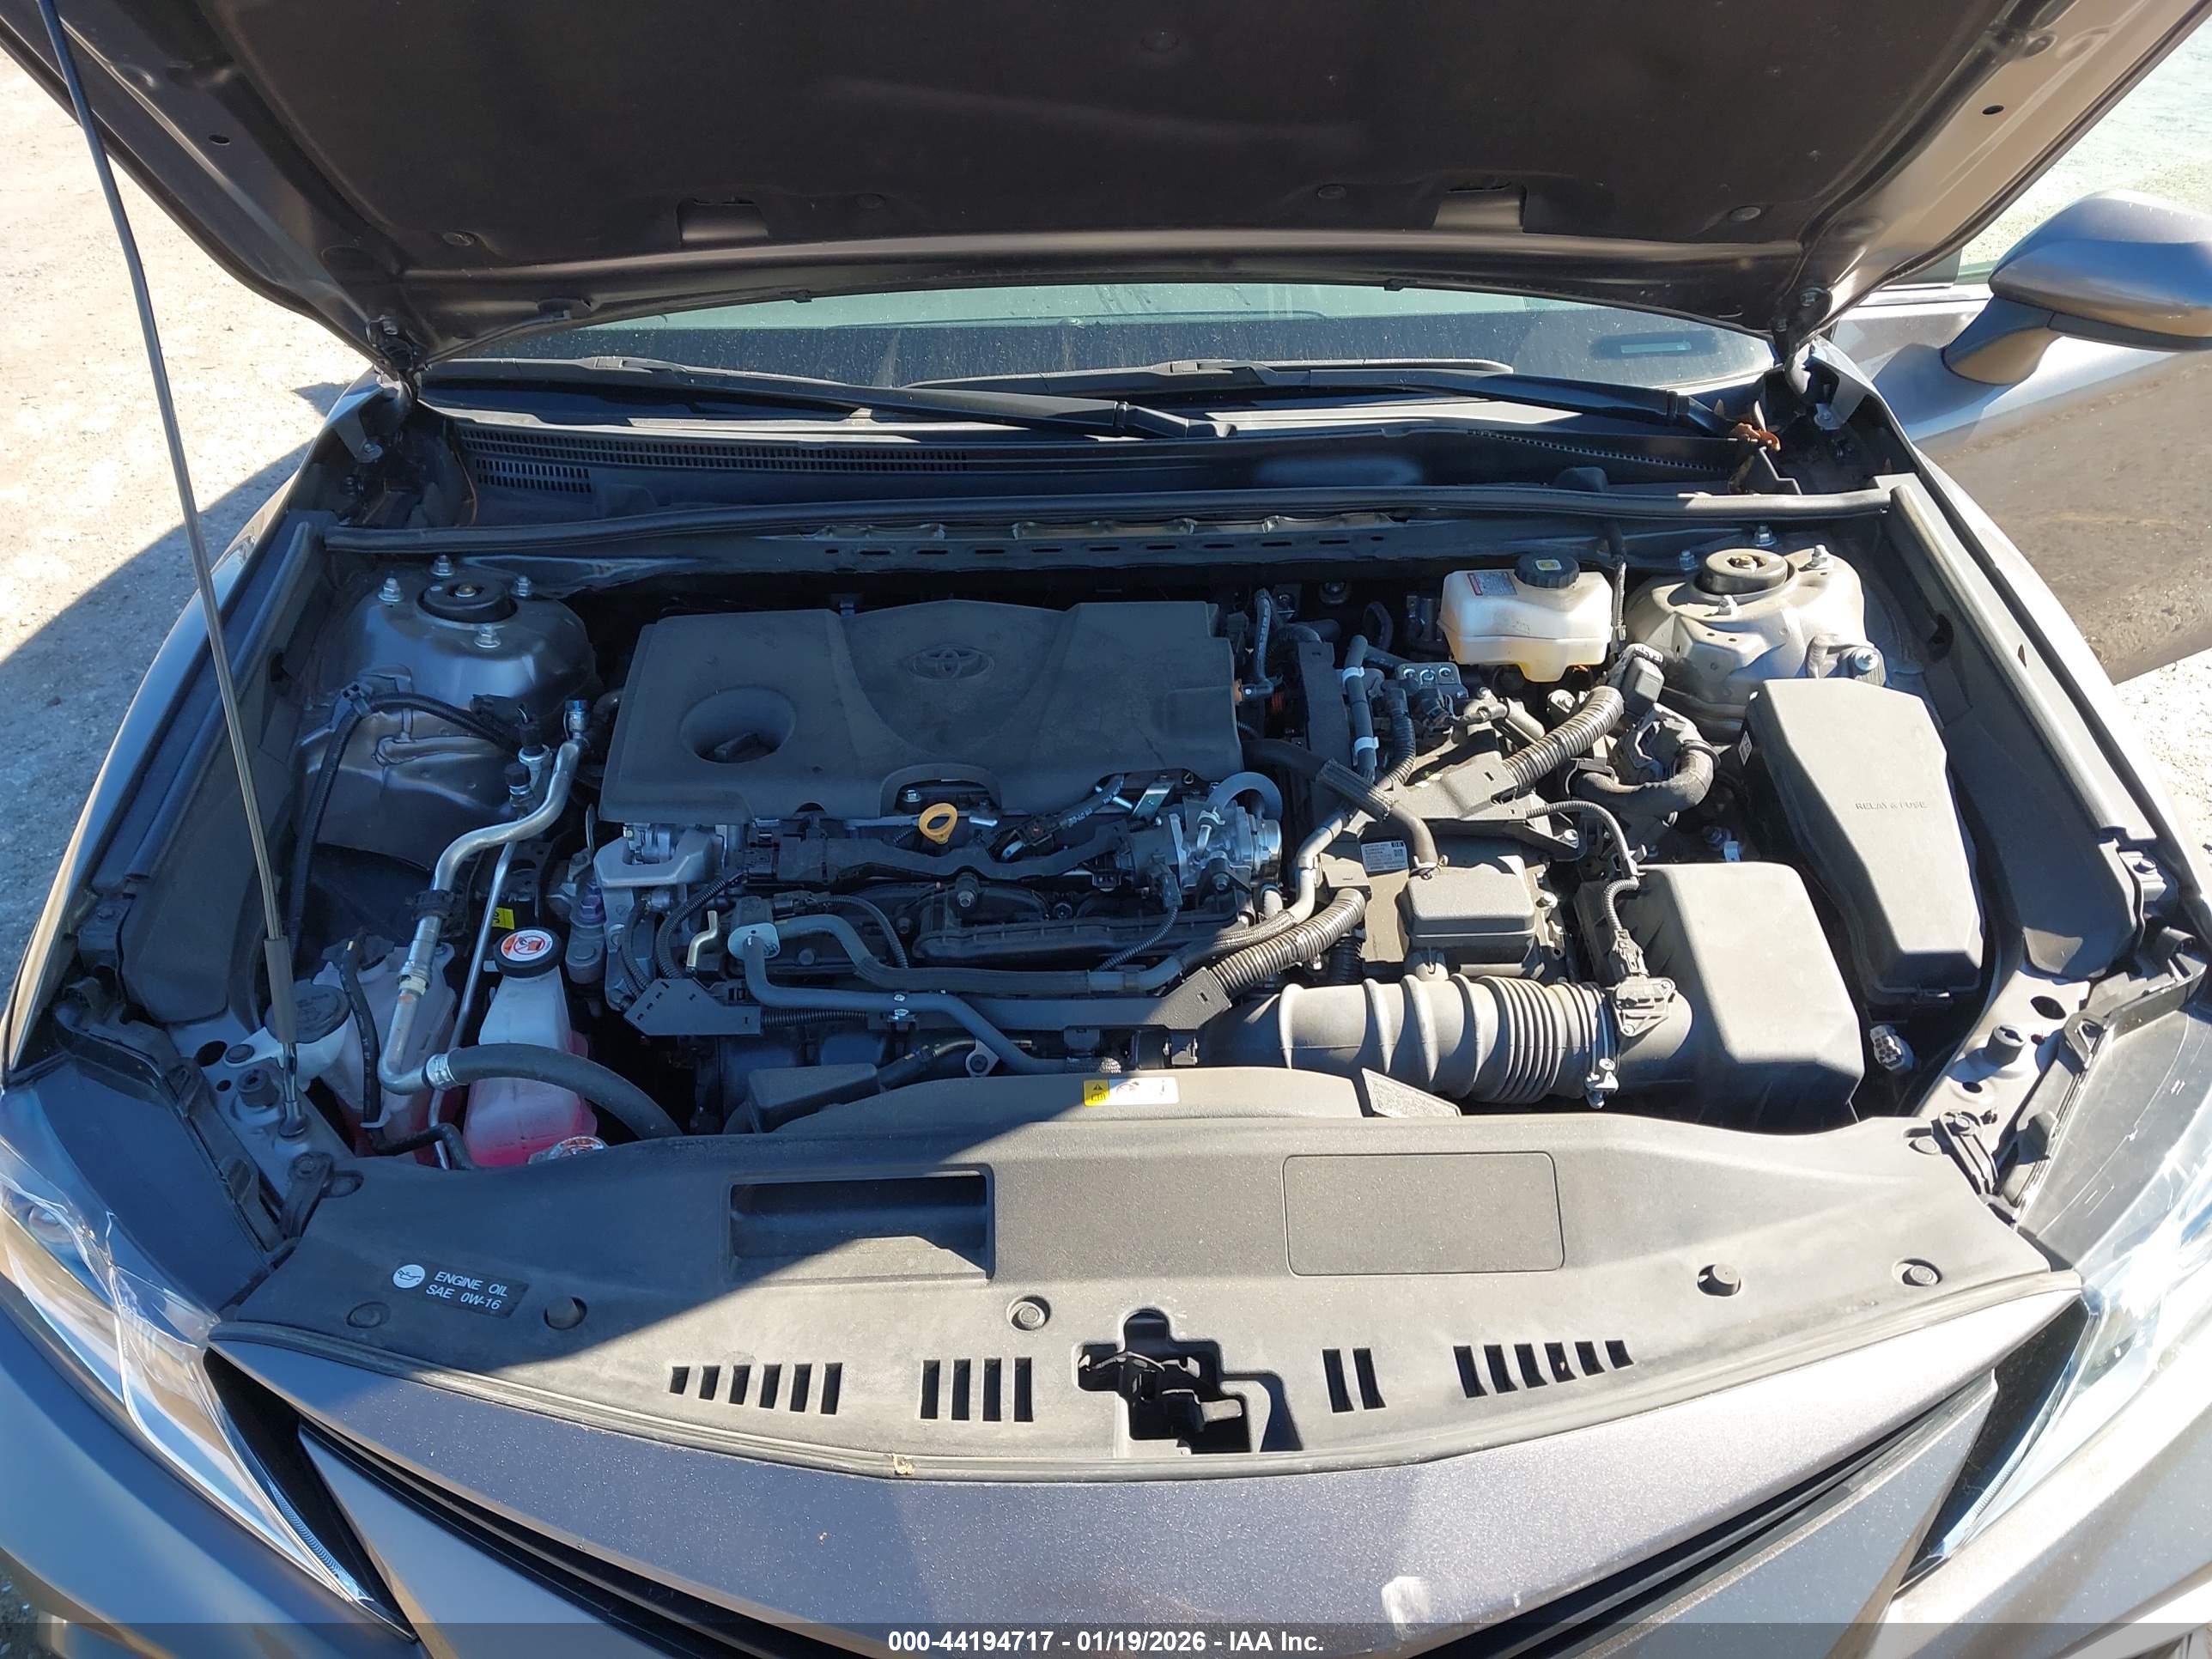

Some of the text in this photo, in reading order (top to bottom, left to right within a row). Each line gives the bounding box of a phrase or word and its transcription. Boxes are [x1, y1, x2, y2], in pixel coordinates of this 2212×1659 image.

[434, 1271, 508, 1297] ENGINE OIL
[426, 1285, 501, 1310] SAE 0W-16
